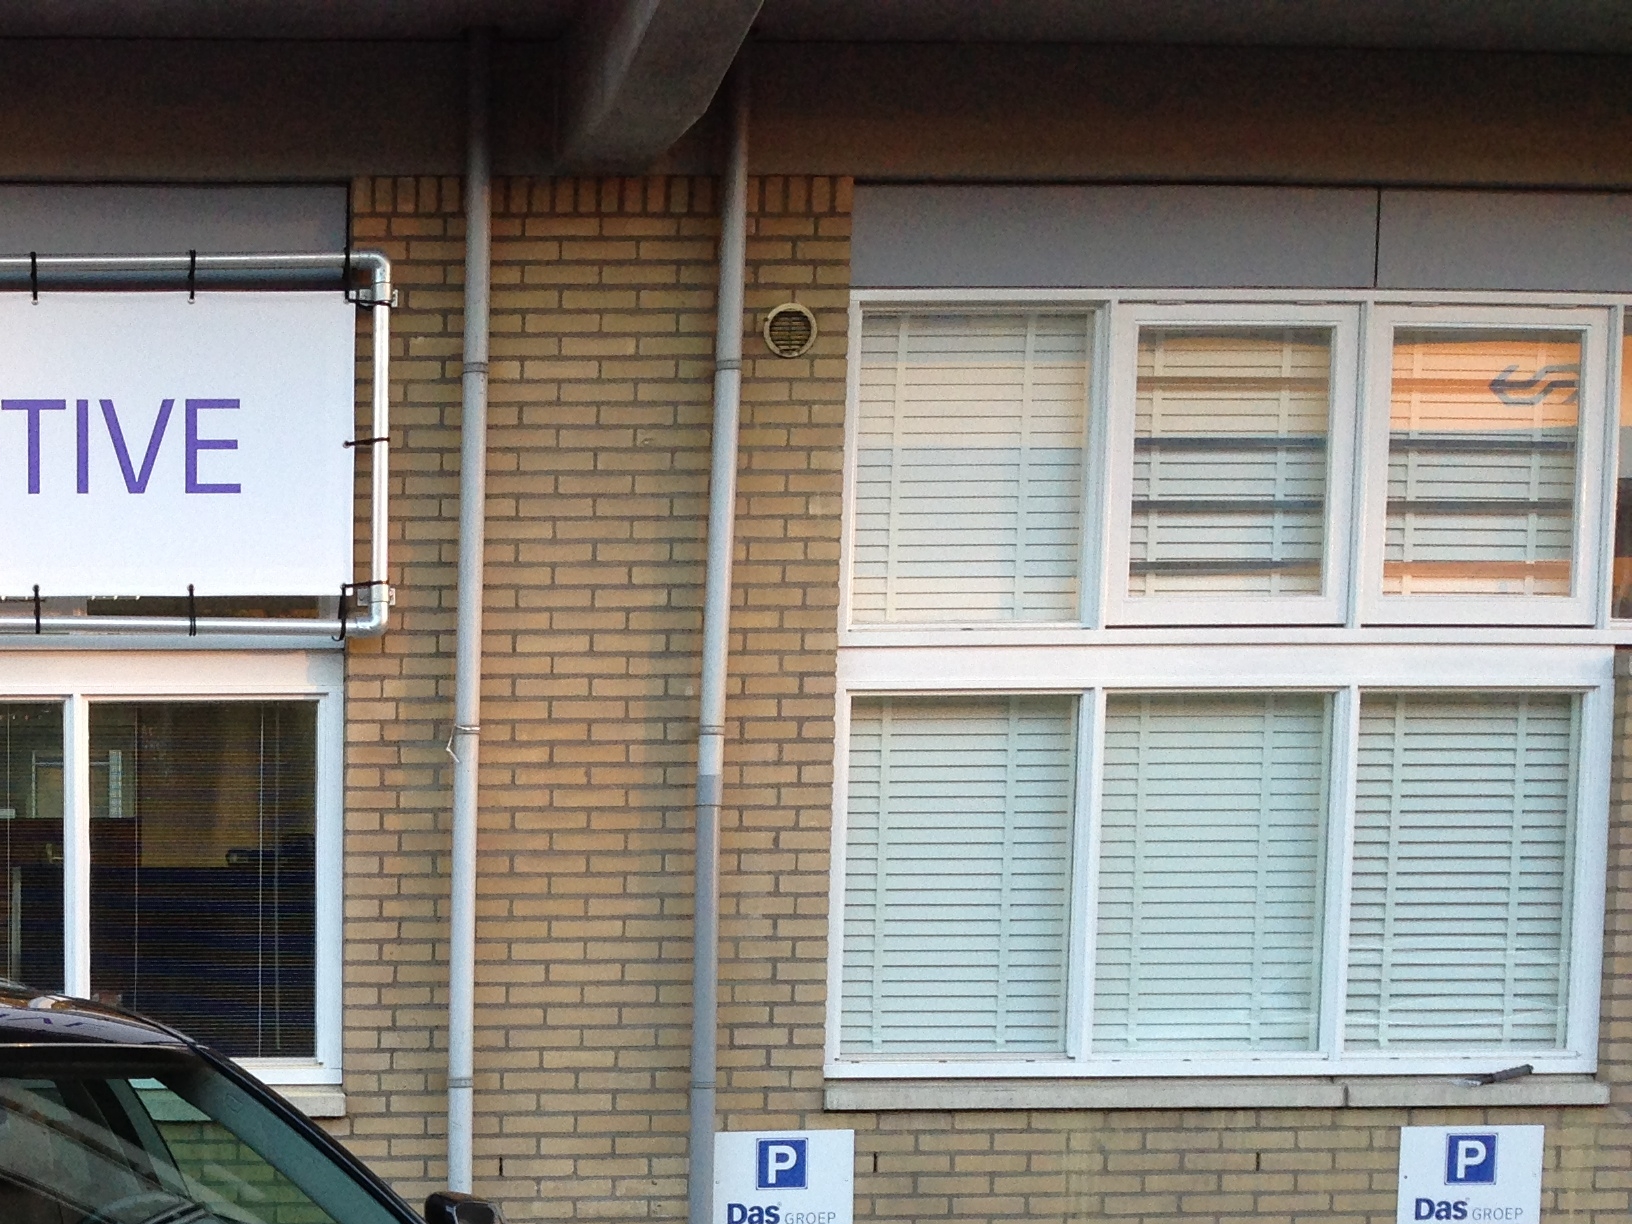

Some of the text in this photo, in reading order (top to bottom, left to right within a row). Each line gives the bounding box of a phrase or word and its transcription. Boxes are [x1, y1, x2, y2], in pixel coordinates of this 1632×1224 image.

[767, 1144, 798, 1184] P
[1456, 1139, 1488, 1179] P
[1414, 1197, 1524, 1221] Das GROEP
